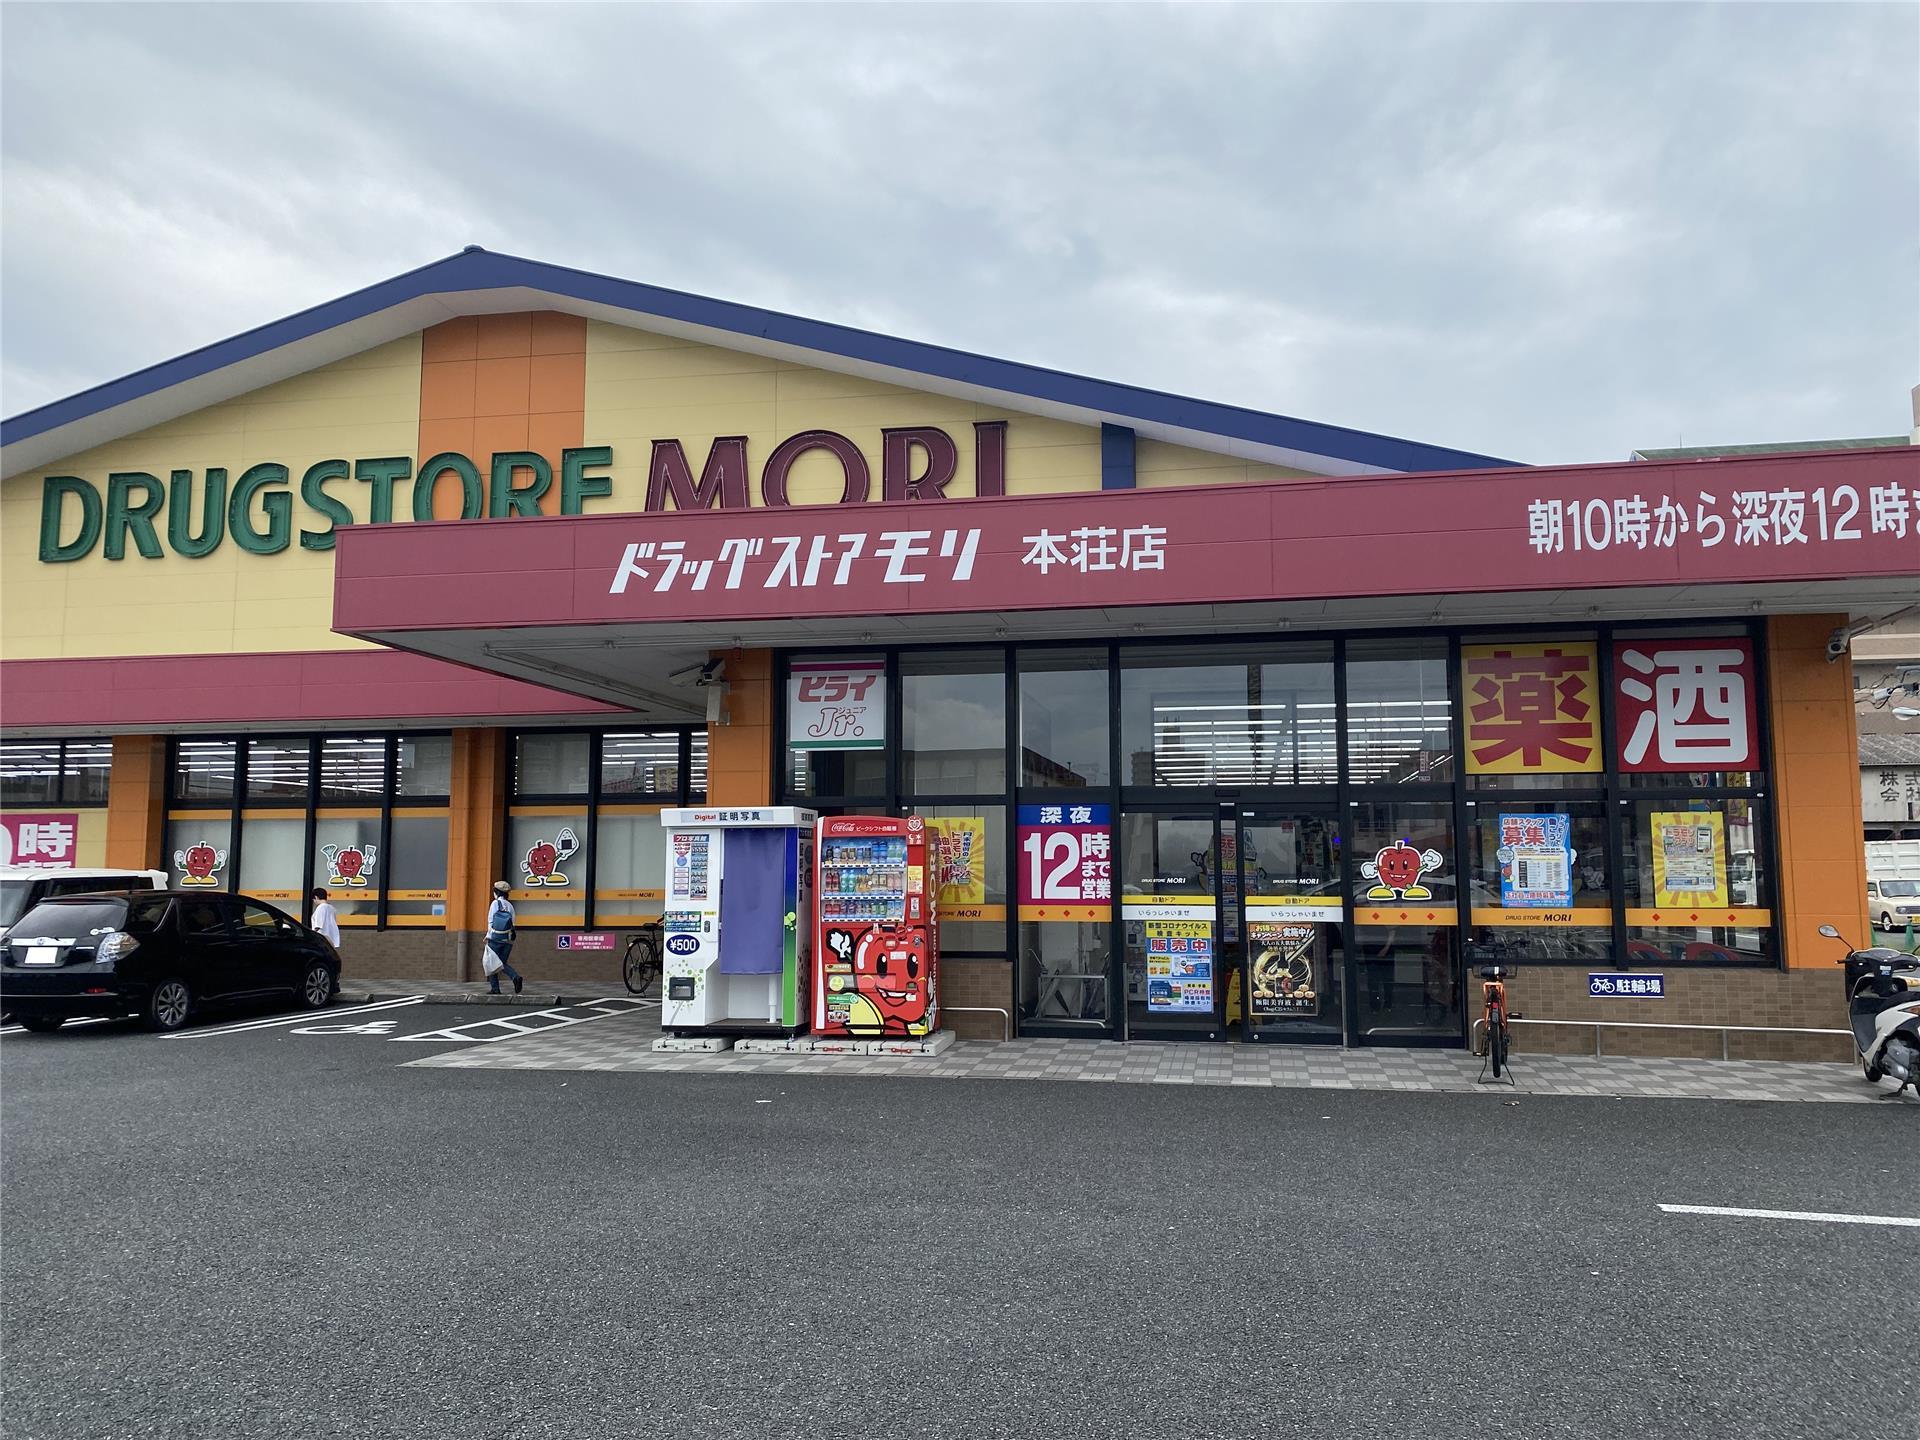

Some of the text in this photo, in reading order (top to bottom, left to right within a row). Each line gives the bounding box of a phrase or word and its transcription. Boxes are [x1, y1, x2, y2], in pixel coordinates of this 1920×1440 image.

[644, 420, 1009, 512] MORI
[1021, 524, 1168, 576] 本荘店
[798, 675, 877, 702] ヒライ
[838, 706, 867, 714] ジュニア
[1468, 650, 1593, 767] 薬
[1620, 649, 1749, 766] 酒
[808, 707, 864, 737] Jr.
[719, 811, 761, 821] 証明写真
[1040, 806, 1092, 824] 深夜
[1503, 826, 1545, 846] 募集
[1081, 860, 1111, 877] まで
[1081, 878, 1111, 900] 営業
[957, 910, 981, 918] MORI
[670, 939, 697, 951] ¥500
[1151, 939, 1207, 952] 販売中
[1616, 979, 1661, 993] 駐輪場
